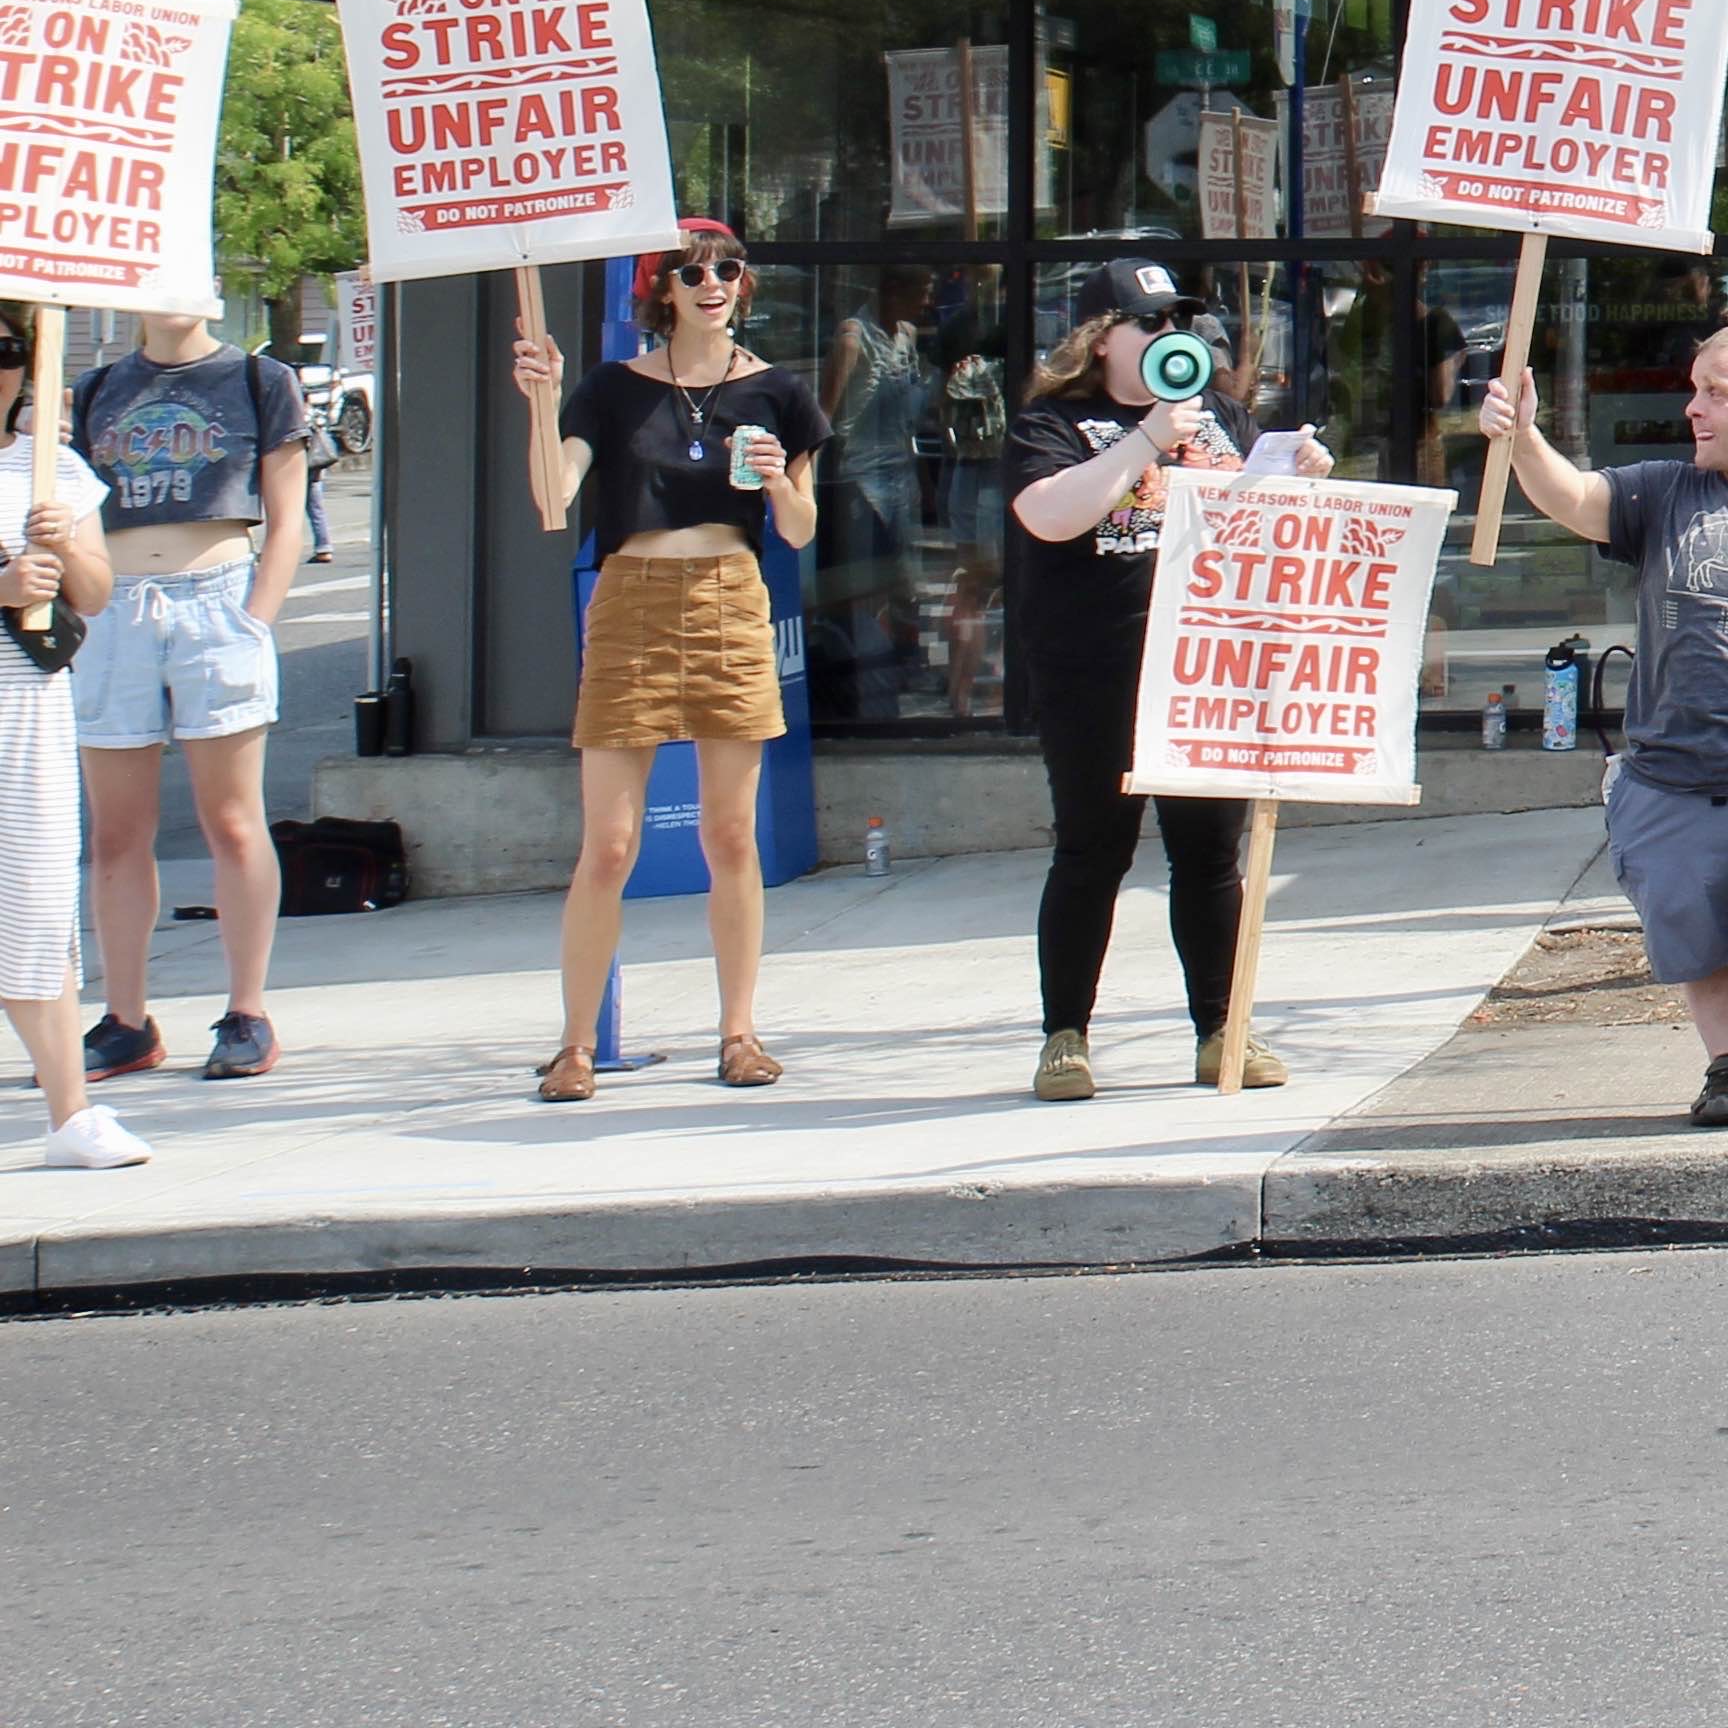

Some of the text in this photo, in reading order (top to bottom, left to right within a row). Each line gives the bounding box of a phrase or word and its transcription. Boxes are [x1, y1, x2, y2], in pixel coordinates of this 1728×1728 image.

[44, 12, 108, 54] ON
[90, 0, 144, 17] LABOR
[152, 9, 201, 26] UNION
[382, 3, 614, 70] STRIKE
[0, 51, 183, 127] TRIKE
[1434, 64, 1680, 141] UNFAIR
[384, 87, 620, 154] UNFAIR
[0, 144, 164, 210] FAIR
[395, 142, 626, 197] EMPLOYER
[1424, 125, 1668, 187] EMPLOYER
[437, 192, 596, 223] DO NOT PATRONIZE
[1457, 181, 1627, 216] DO NOT PATRONIZE
[0, 203, 160, 252] PLOYER
[33, 259, 126, 281] PATRONIZE
[1485, 304, 1545, 321] SHE
[1605, 304, 1709, 321] HAPPINESS
[118, 470, 192, 509] 1979
[1197, 487, 1413, 518] NEW SEASONS LABOR UNION
[1274, 514, 1332, 551] ON
[1189, 551, 1397, 609] STRIKE
[1174, 637, 1379, 694] UNFAIR
[1168, 696, 1376, 736] EMPLOYER
[1201, 747, 1344, 768] DO NOT PATRONIZE
